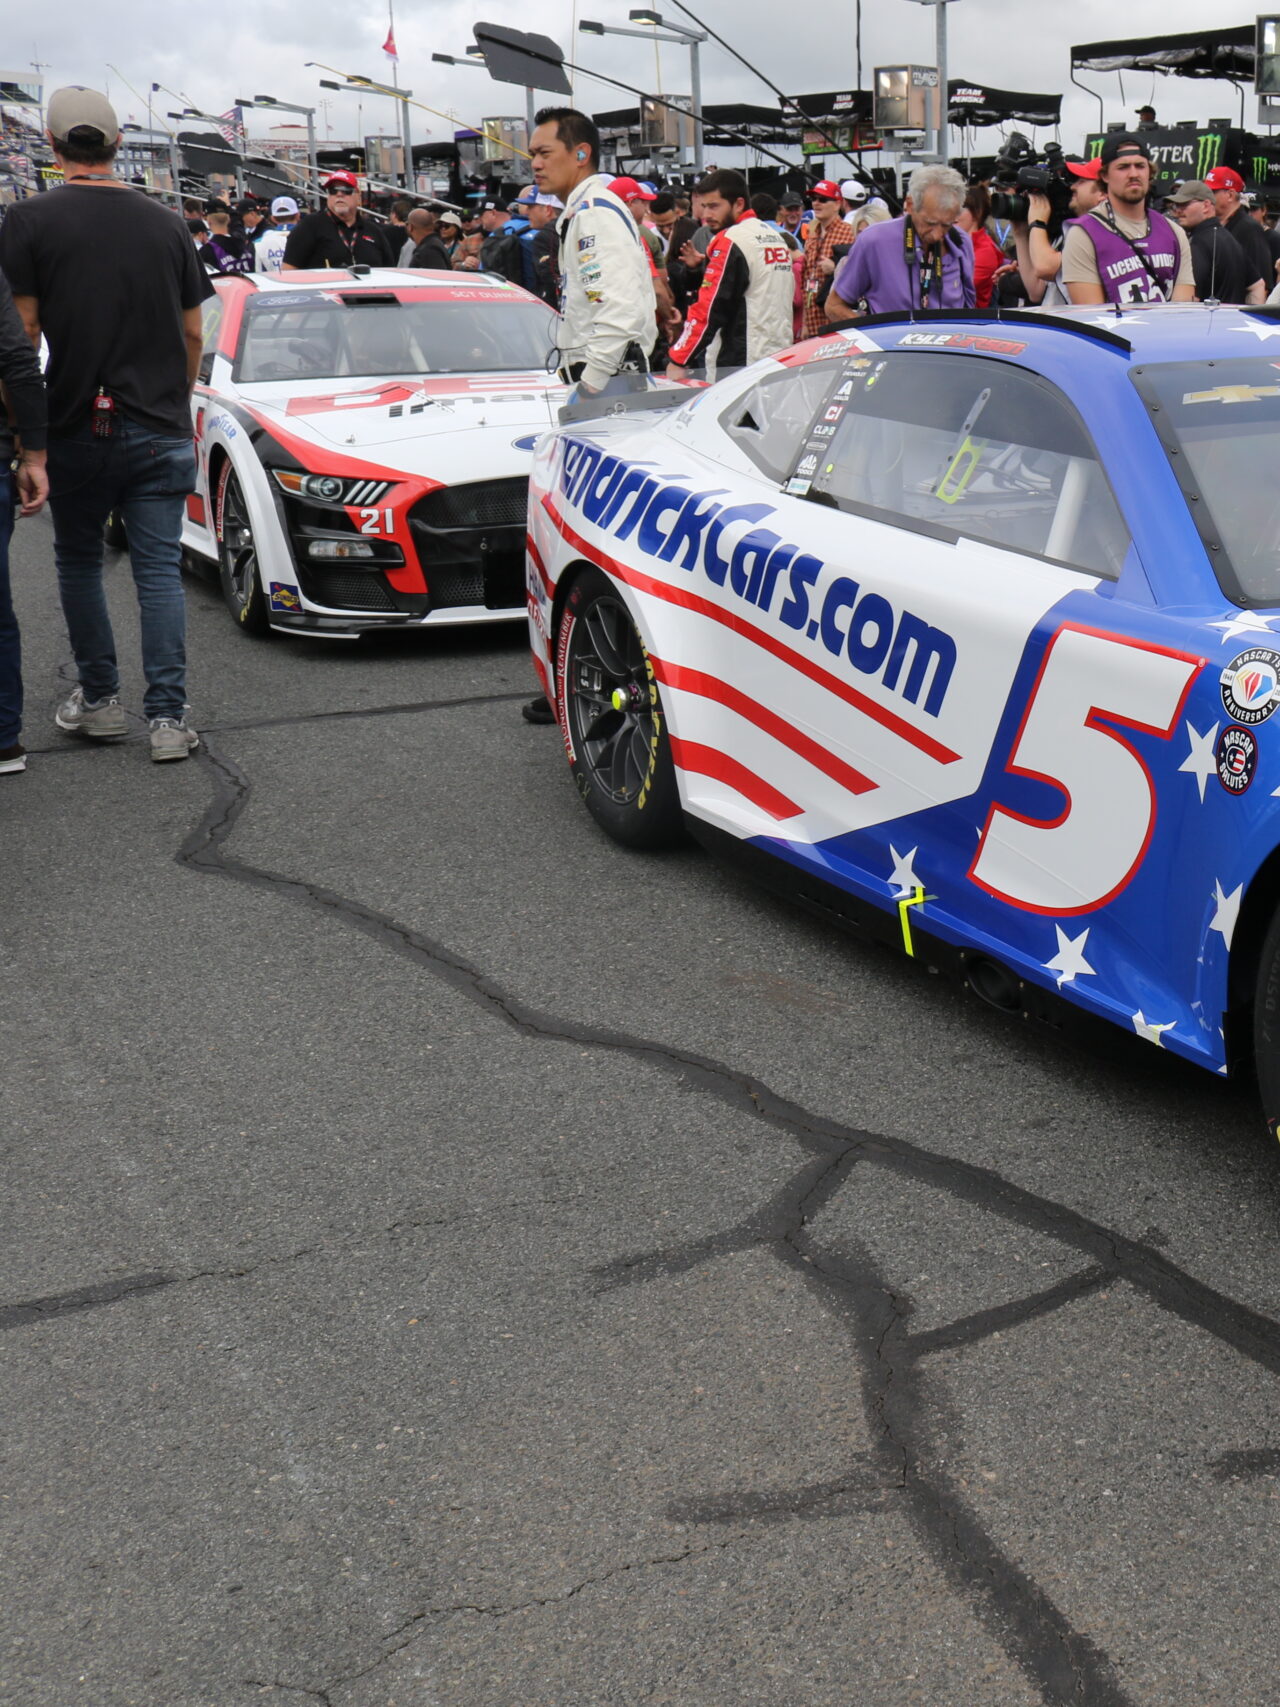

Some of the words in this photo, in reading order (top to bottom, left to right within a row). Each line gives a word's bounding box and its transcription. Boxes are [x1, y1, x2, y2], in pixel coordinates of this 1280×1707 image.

[950, 95, 985, 104] PENSKE
[956, 88, 982, 97] TEAM
[360, 508, 394, 534] 21
[557, 612, 574, 678] REMEMBER
[1236, 650, 1273, 667] NASCAR
[1223, 689, 1274, 722] ANNIVERSARY
[1224, 731, 1254, 758] NASCAR
[967, 621, 1208, 917] 5
[1219, 762, 1249, 789] SALUTES
